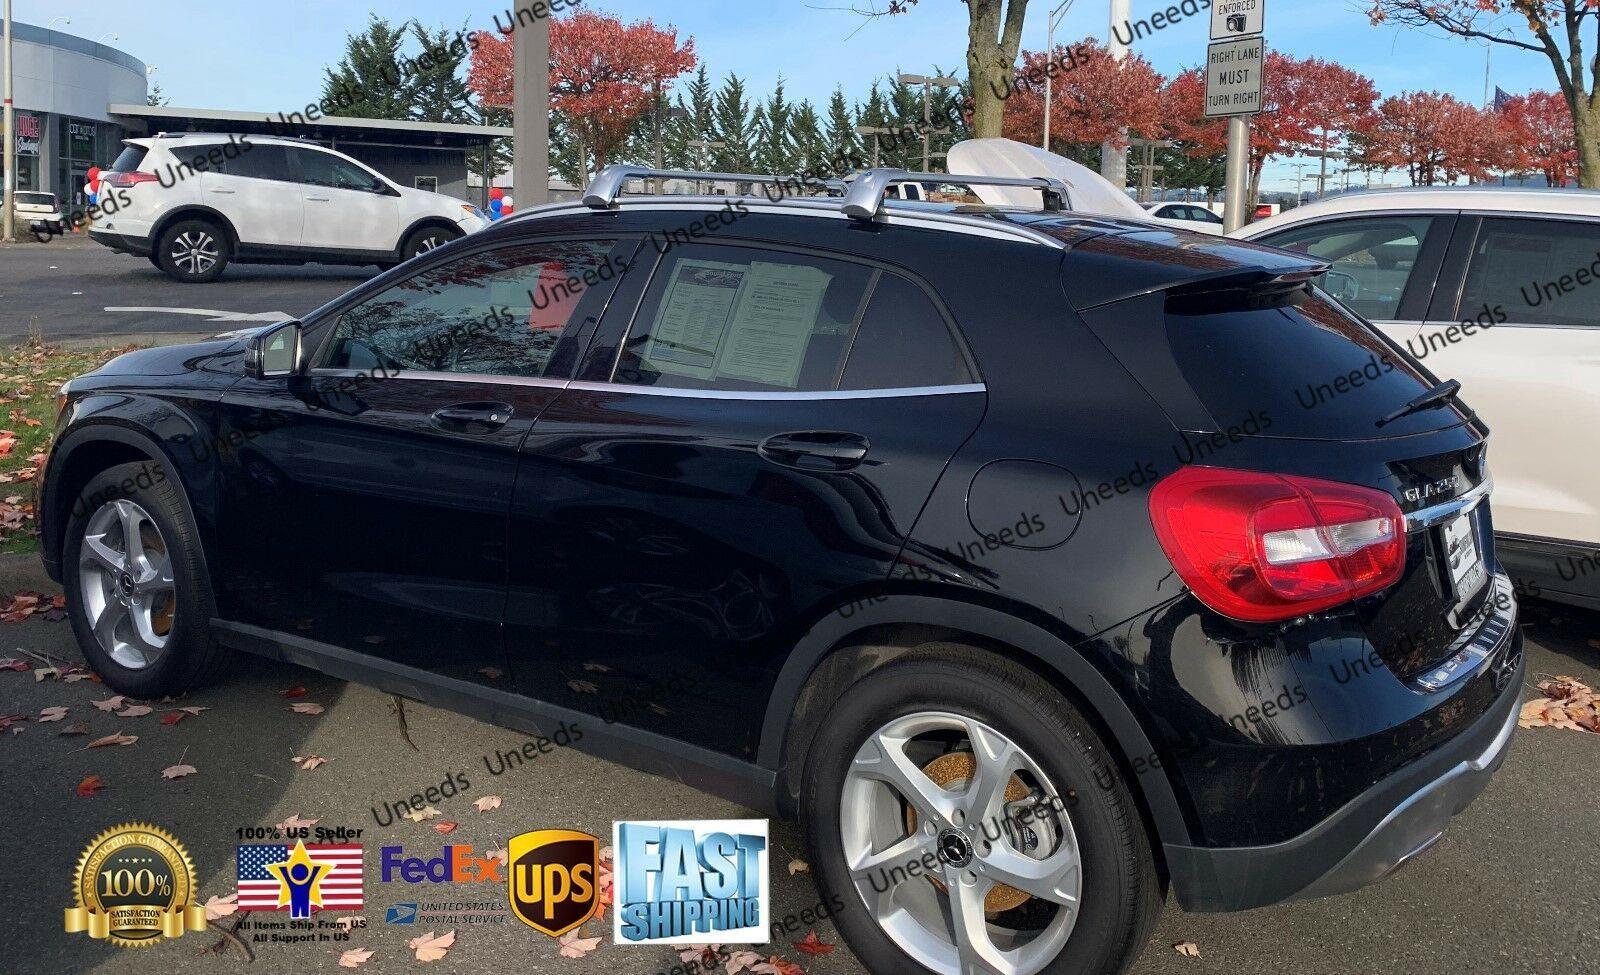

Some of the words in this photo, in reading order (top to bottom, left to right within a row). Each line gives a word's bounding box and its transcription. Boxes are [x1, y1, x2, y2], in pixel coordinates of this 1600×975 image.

[1218, 0, 1256, 16] ENFORCED
[1211, 50, 1235, 64] RIGHT
[1237, 47, 1260, 61] LANE
[1219, 69, 1250, 86] MUST
[1209, 94, 1230, 107] TURN
[1234, 91, 1258, 104] RIGHT
[18, 115, 38, 137] HUGE
